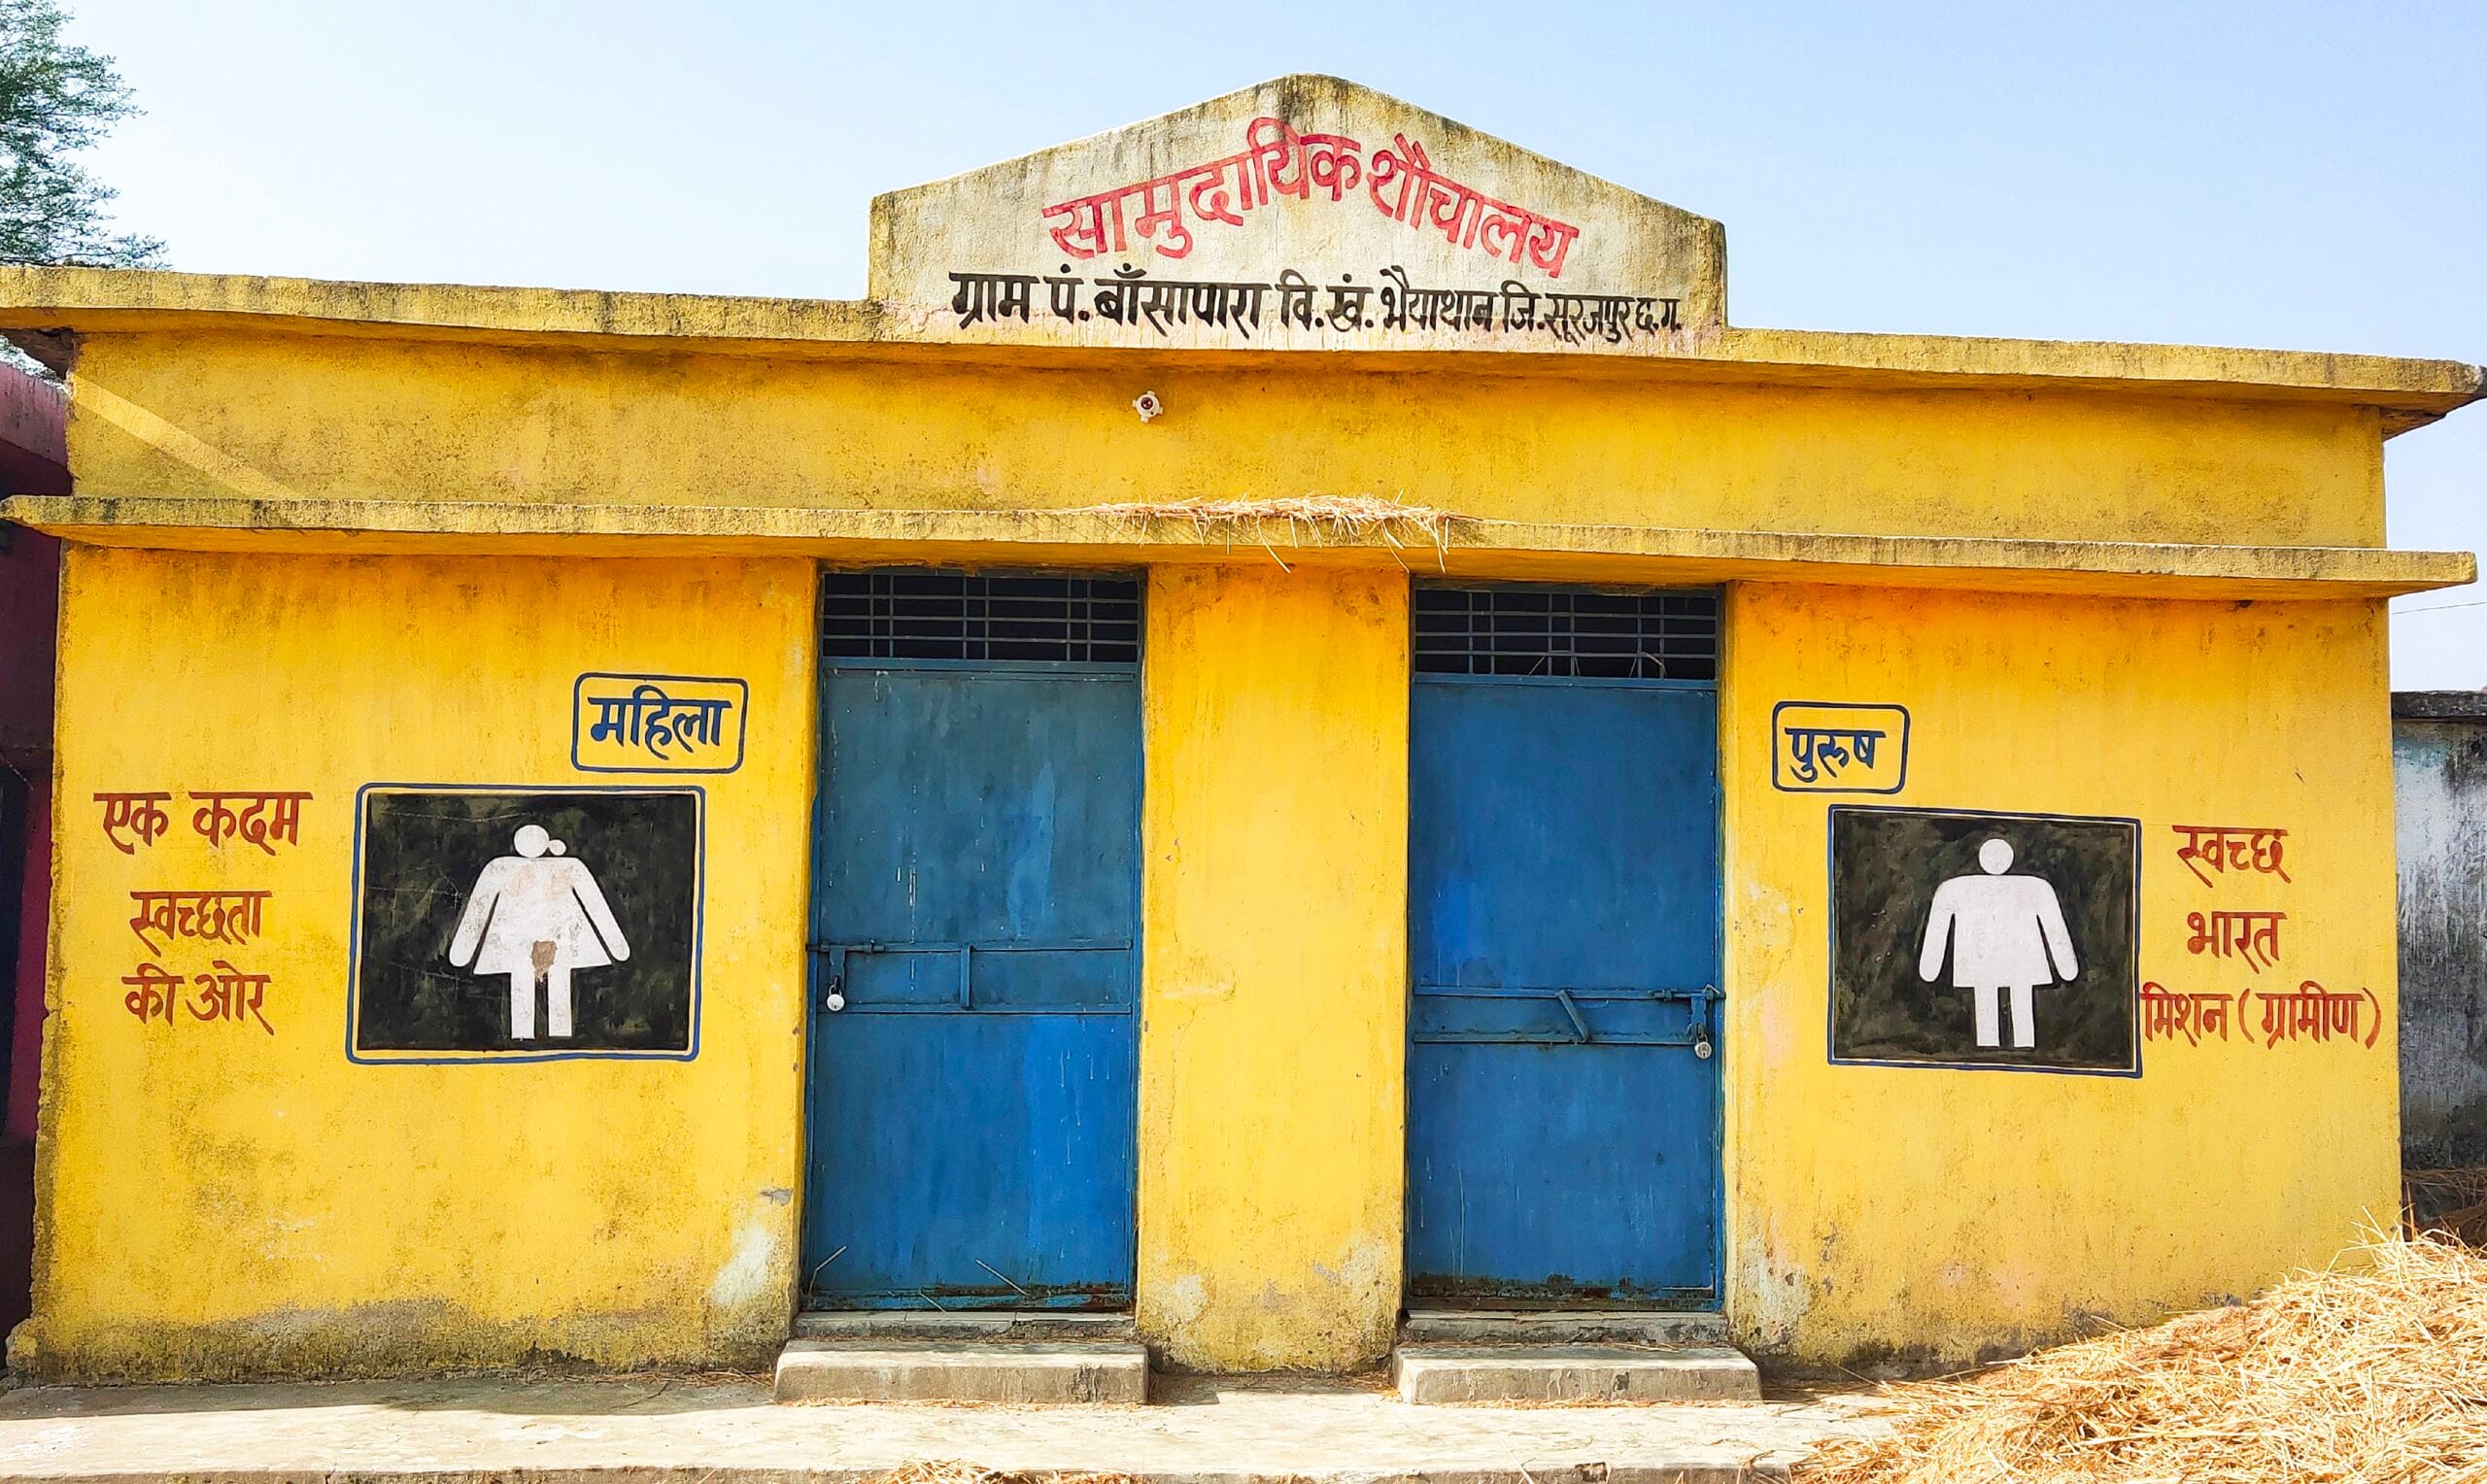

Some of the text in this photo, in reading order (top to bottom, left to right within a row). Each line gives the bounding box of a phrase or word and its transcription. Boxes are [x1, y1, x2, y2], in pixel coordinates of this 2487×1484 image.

[1041, 118, 1580, 278] सामुदायिक शौचालय
[948, 271, 1040, 330] ग्राम
[587, 684, 732, 760] महिला
[1784, 727, 1887, 783] पुरुष
[93, 791, 314, 856] एक कदम
[2171, 825, 2292, 889] स्वच्छ
[129, 891, 273, 957] स्वच्छता
[2187, 911, 2287, 974] भारत
[121, 960, 275, 1036] की ओर
[2139, 981, 2234, 1048] मिशन
